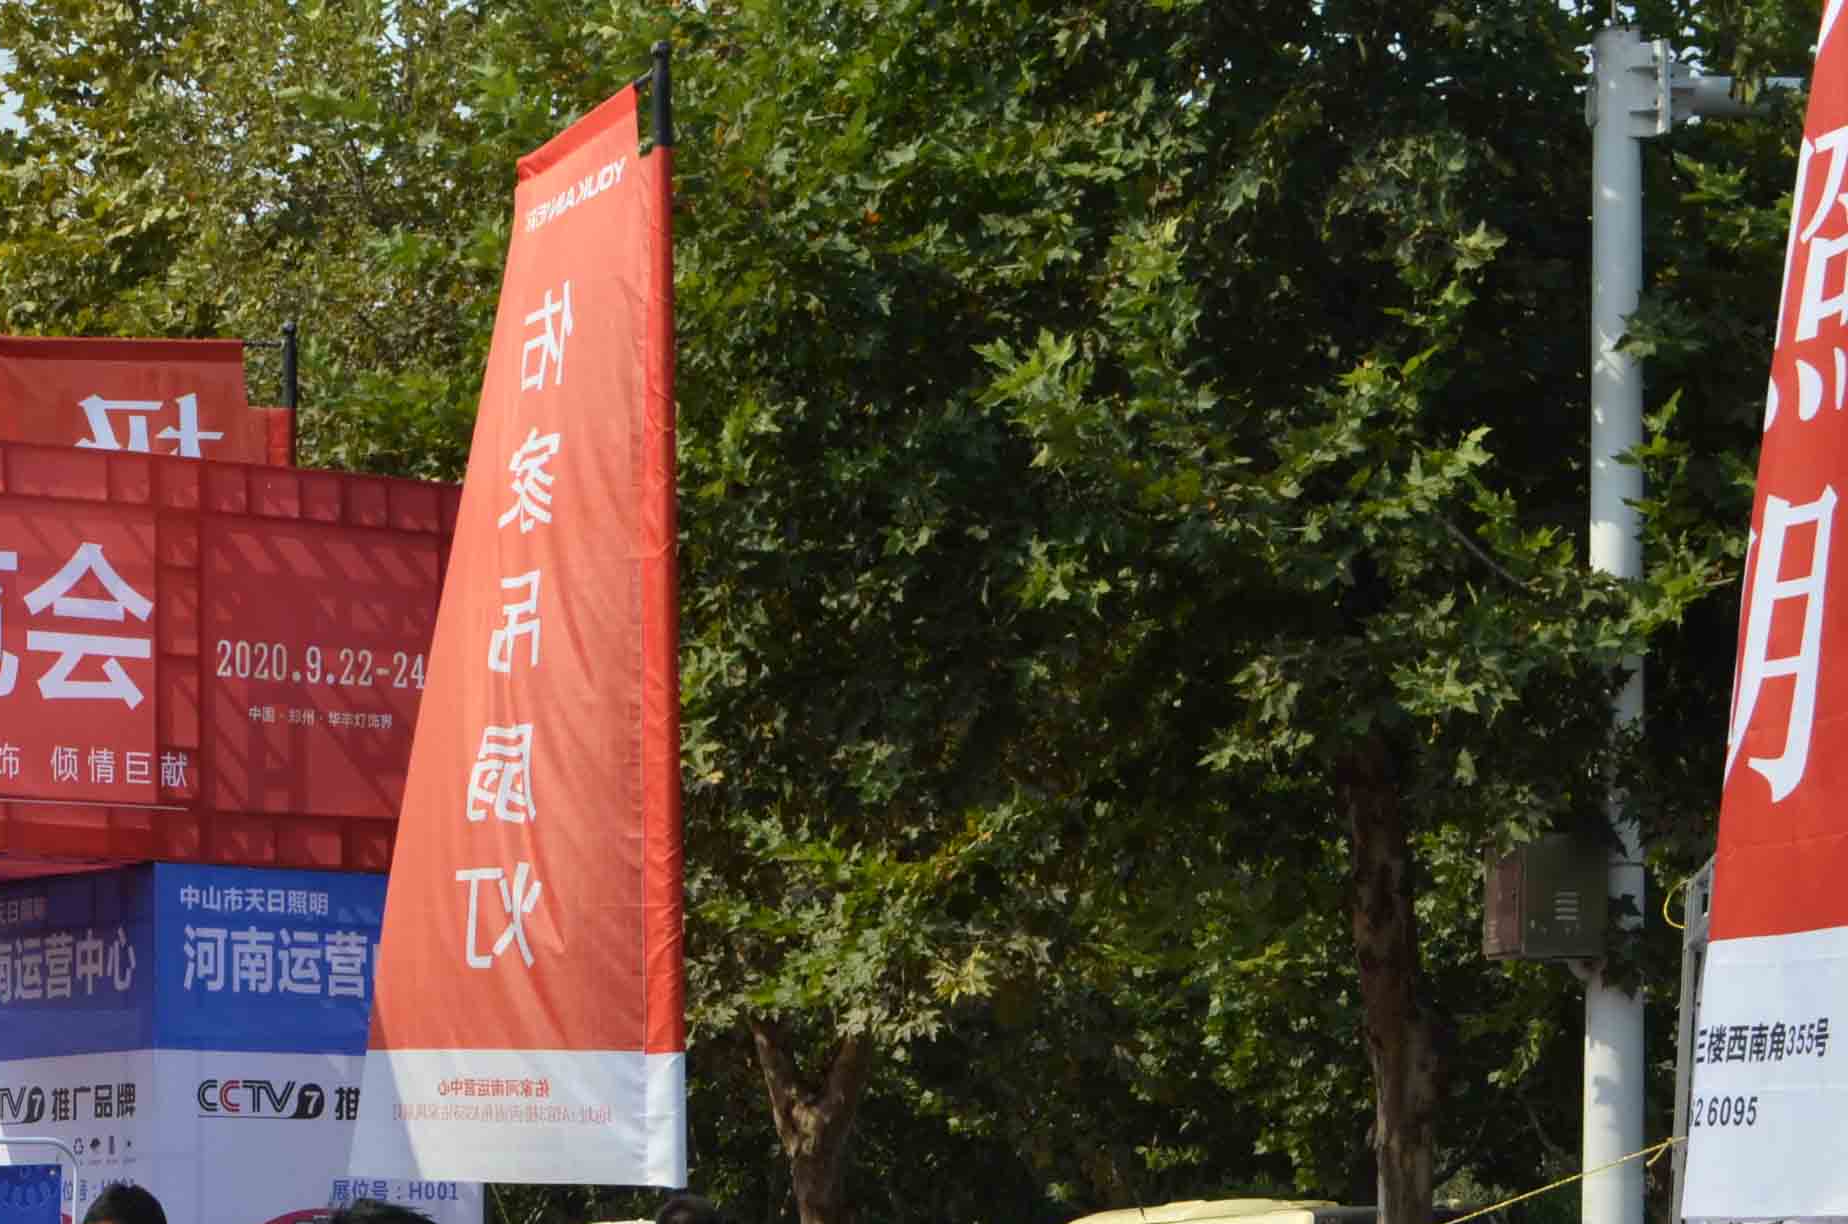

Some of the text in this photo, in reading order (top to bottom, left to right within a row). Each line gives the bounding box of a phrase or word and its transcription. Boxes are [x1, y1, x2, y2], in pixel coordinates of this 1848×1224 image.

[216, 639, 426, 689] 2020.9.22-24
[49, 743, 190, 789] 倾情巨献
[179, 884, 330, 917] 中山市天日照明
[182, 925, 378, 1000] 河南运营
[51, 1083, 137, 1122] 推广品牌
